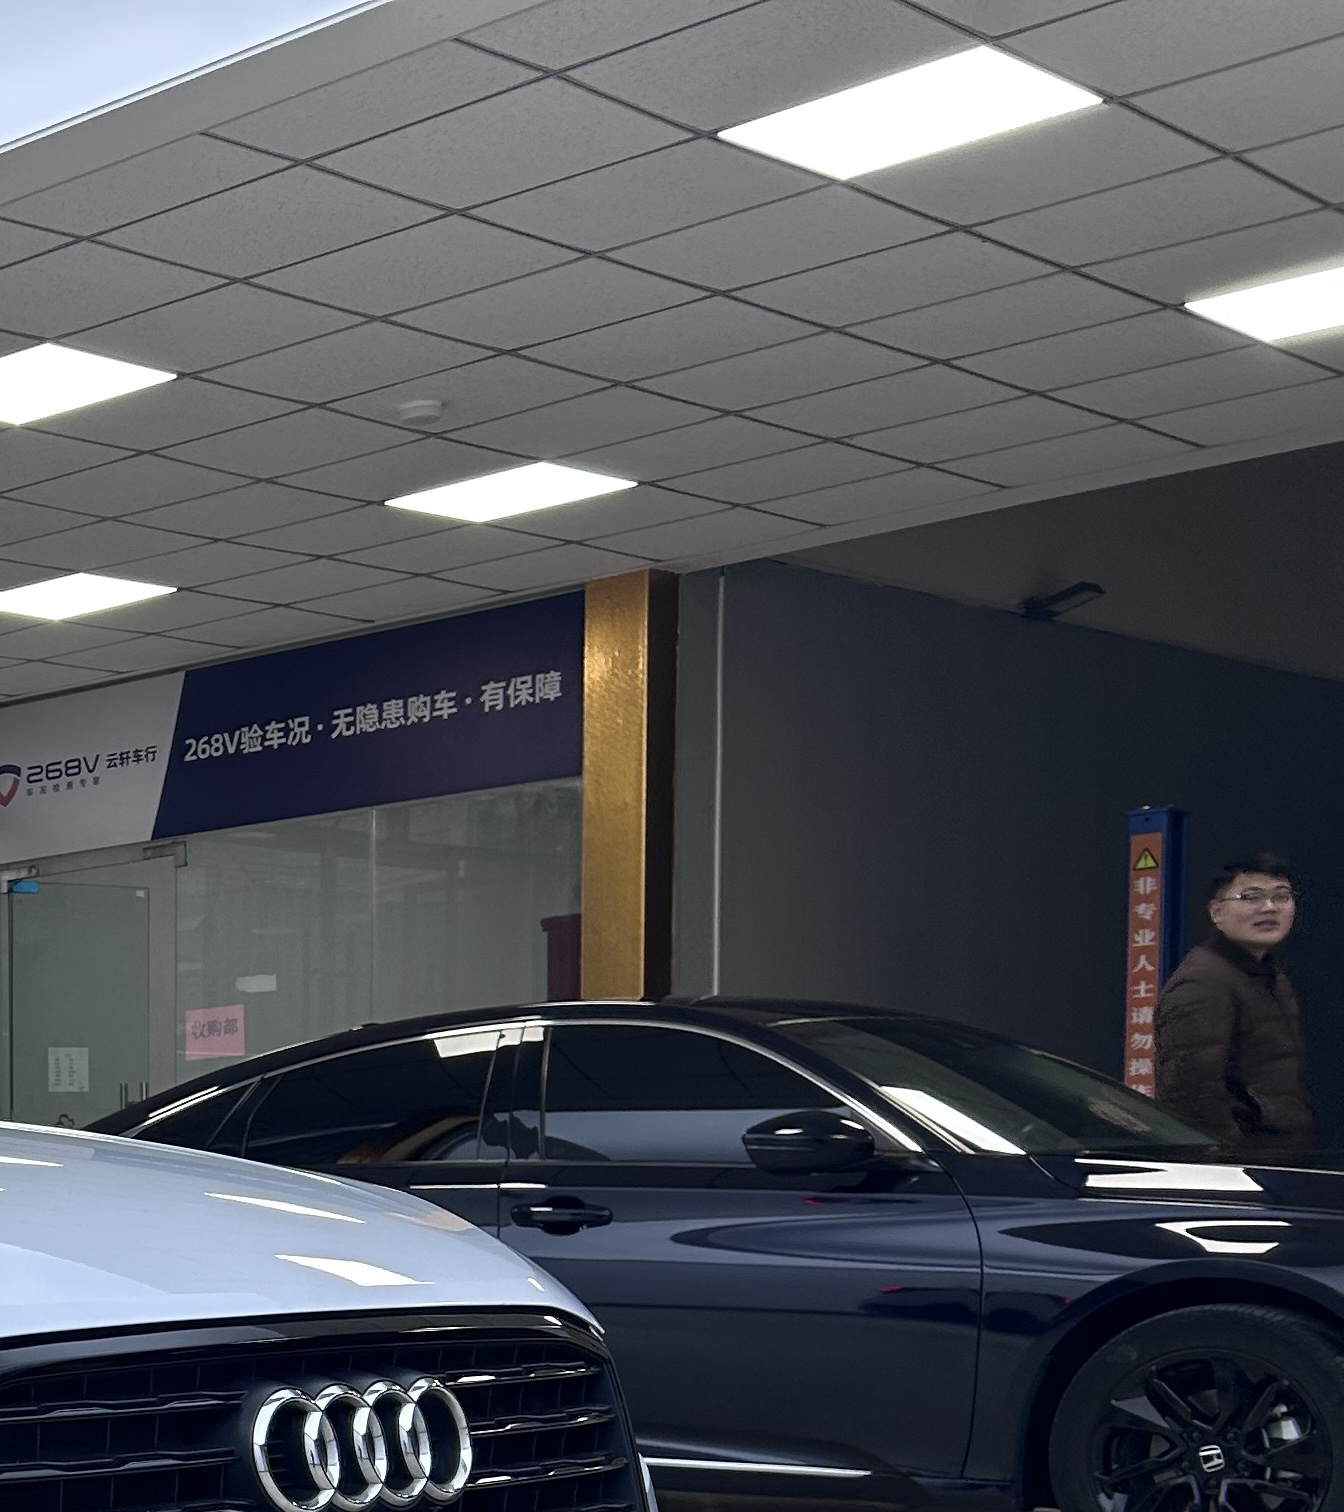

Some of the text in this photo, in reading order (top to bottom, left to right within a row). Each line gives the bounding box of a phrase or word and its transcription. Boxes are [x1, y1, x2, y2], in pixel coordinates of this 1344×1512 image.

[26, 745, 158, 784] 268V 云轩车行
